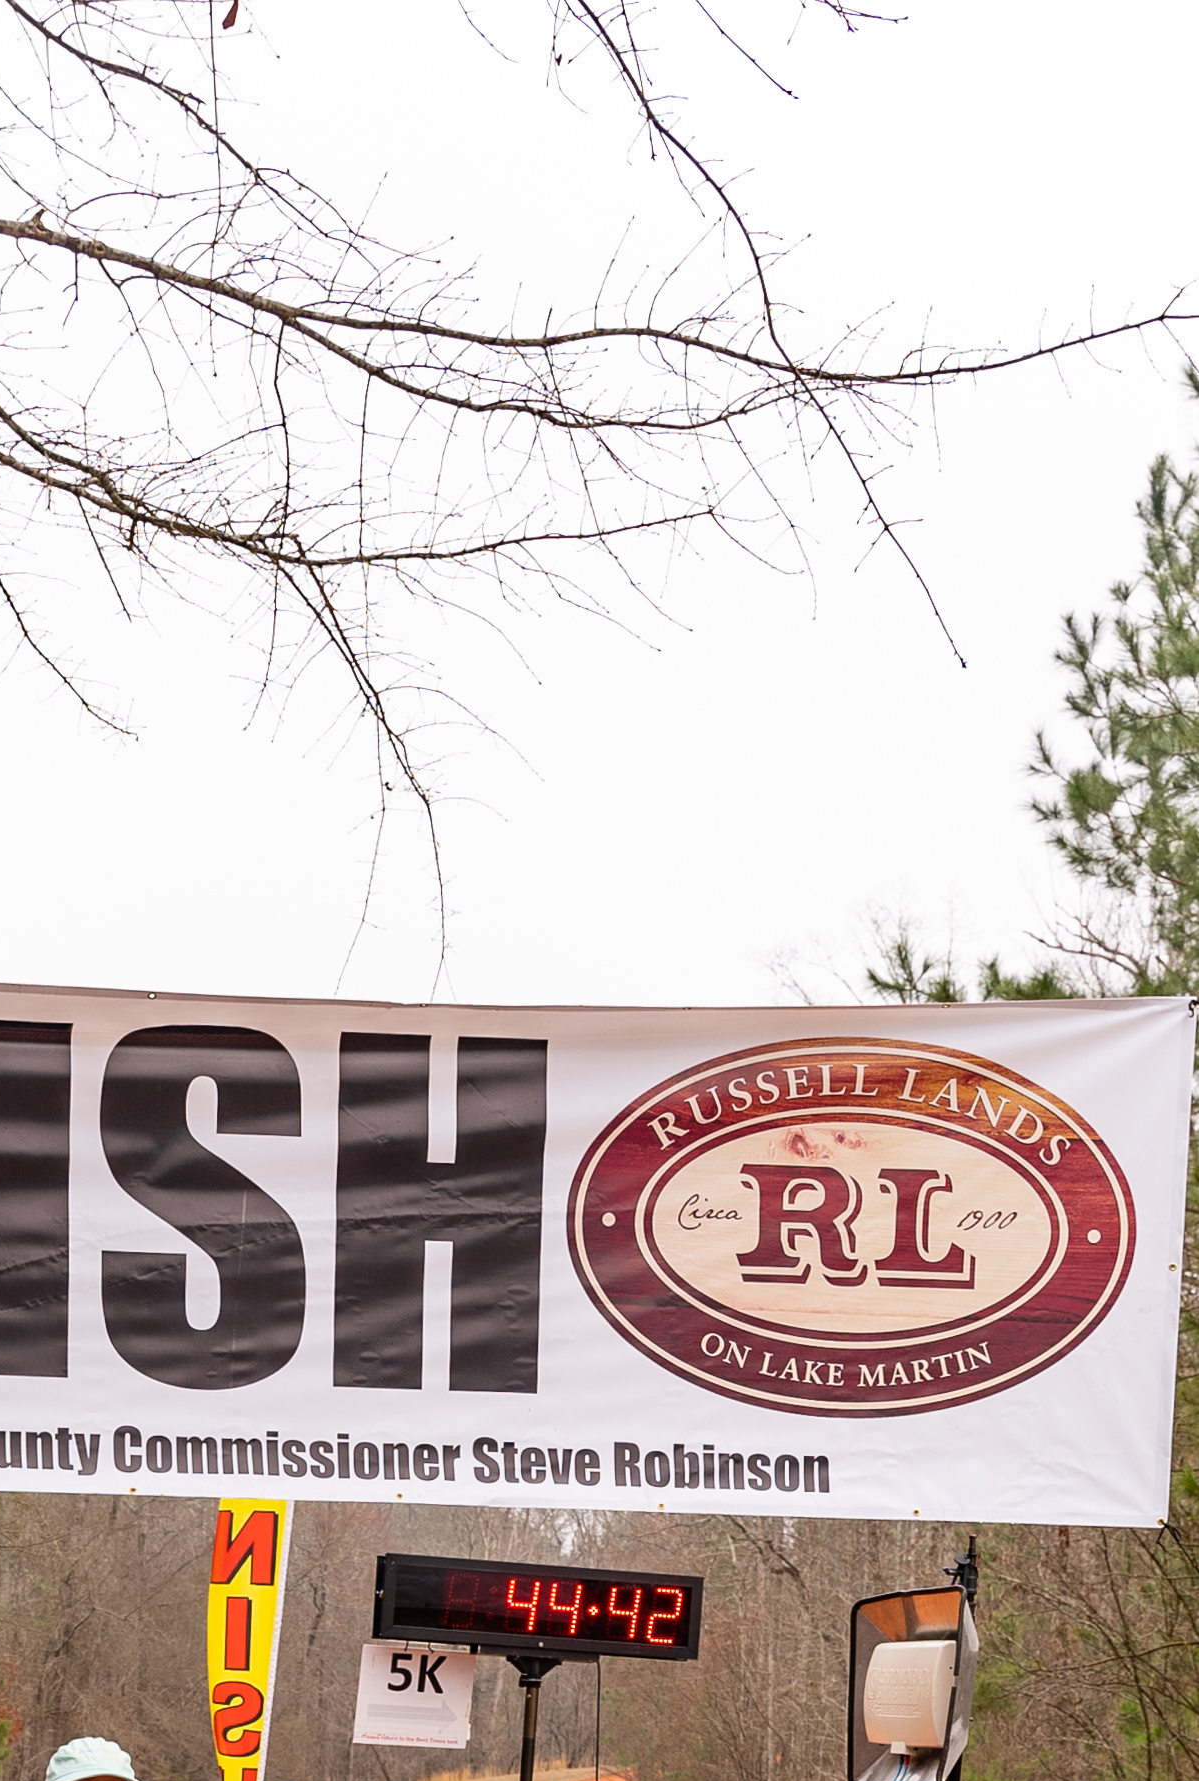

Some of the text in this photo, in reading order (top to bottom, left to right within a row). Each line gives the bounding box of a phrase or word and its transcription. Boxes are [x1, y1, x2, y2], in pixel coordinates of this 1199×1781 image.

[647, 1063, 1071, 1167] RUSSELL LANDS
[678, 1162, 1018, 1289] Circa RL 1900
[701, 1332, 994, 1388] ON LAKE MARTIN
[113, 1425, 461, 1482] Commissioner
[473, 1437, 601, 1487] Steve
[614, 1441, 831, 1493] Robinson
[387, 1652, 447, 1694] 5K
